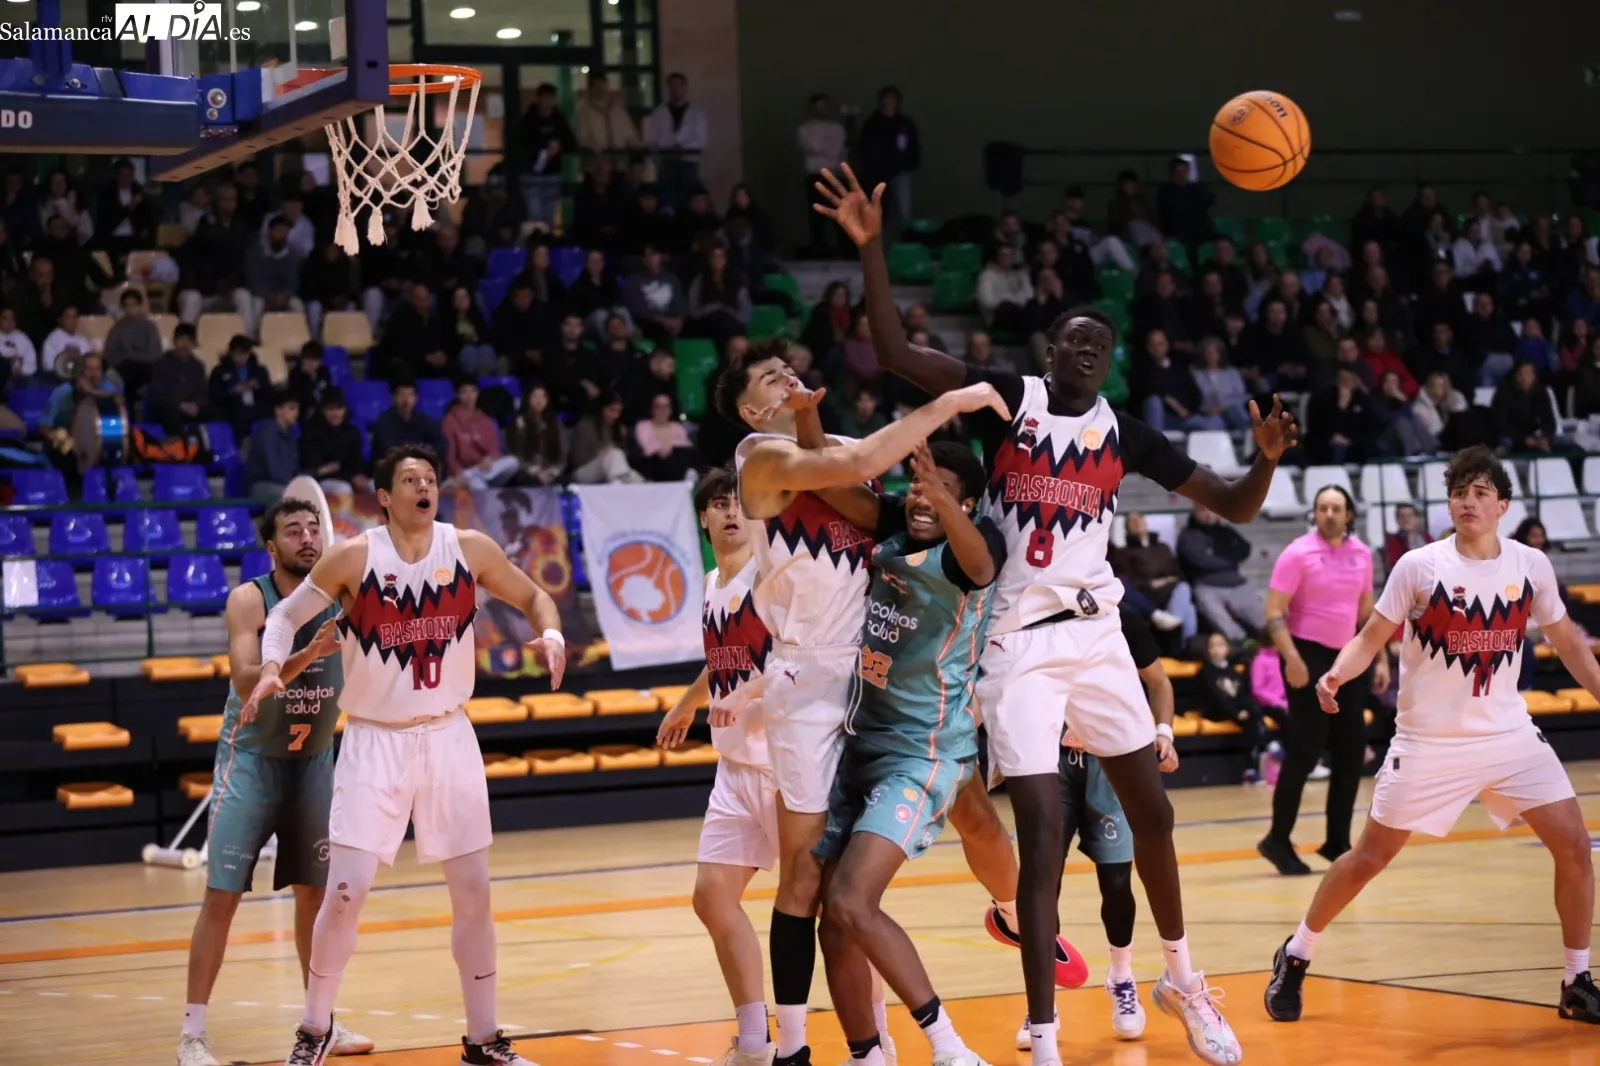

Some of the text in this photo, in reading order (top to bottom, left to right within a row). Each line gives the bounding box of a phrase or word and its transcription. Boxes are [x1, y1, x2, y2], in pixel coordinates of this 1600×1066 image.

[1004, 472, 1102, 520] BASKONIA
[1026, 528, 1054, 569] 8
[380, 614, 459, 650] BASKONI
[410, 656, 441, 690] 10
[285, 699, 320, 715] salud
[288, 723, 311, 751] 7
